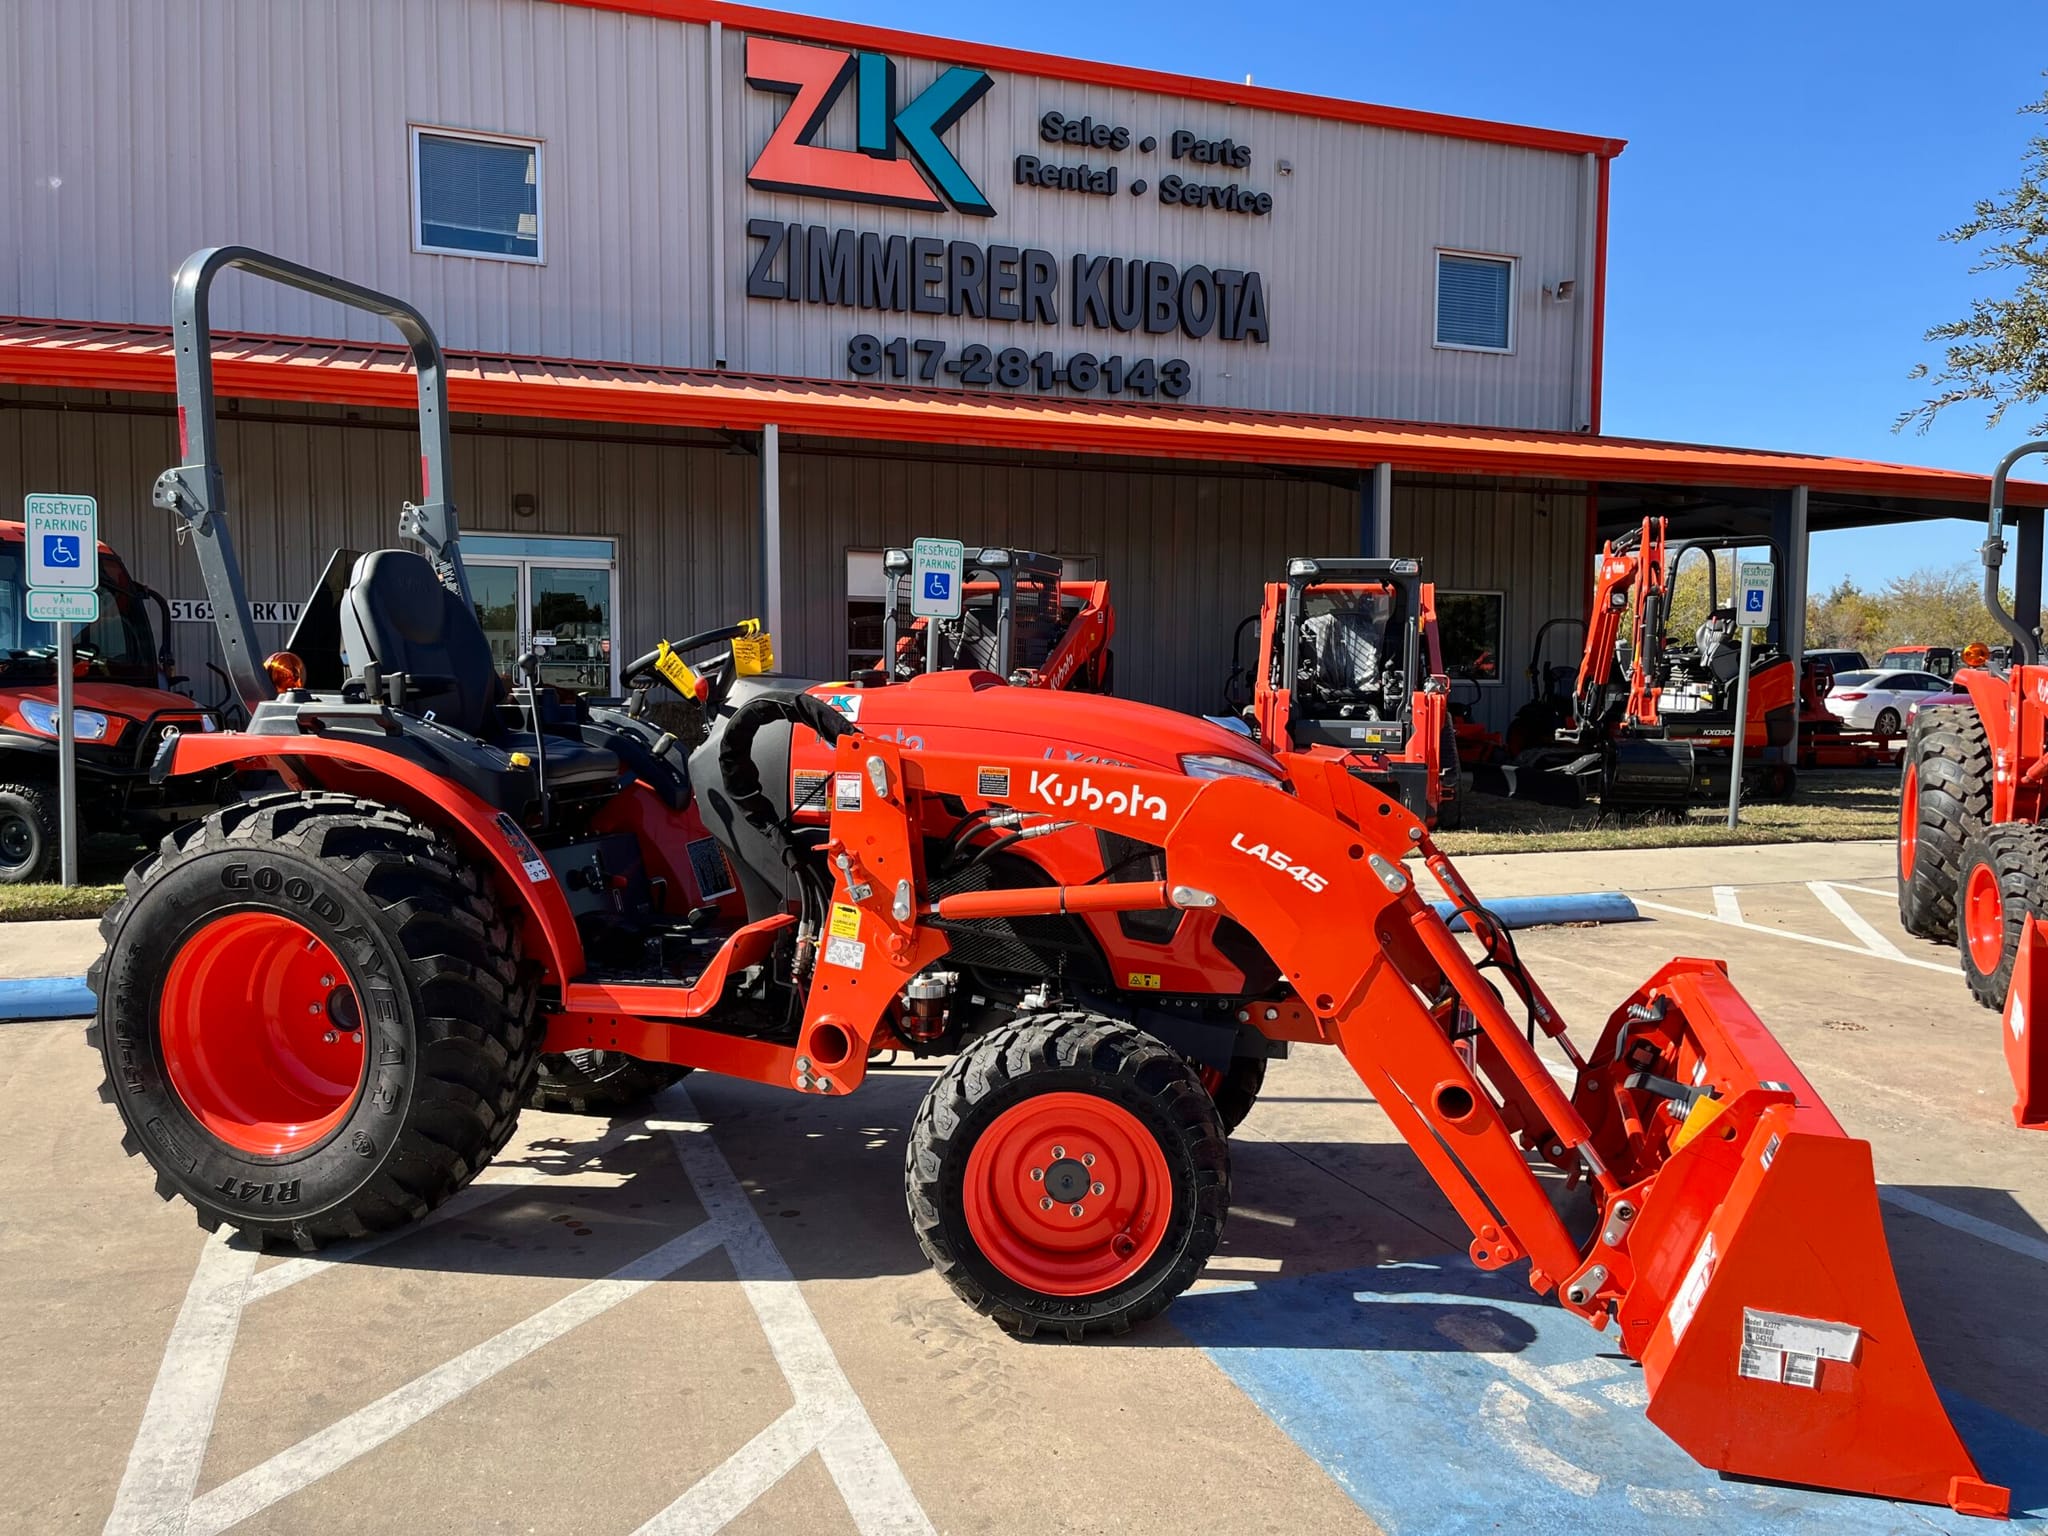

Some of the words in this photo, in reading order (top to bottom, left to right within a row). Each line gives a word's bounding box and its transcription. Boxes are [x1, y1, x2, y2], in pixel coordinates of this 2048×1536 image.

[745, 35, 997, 218] ZK
[1041, 110, 1129, 153] Sales
[1172, 129, 1251, 170] Parts
[1016, 154, 1117, 197] Rental
[1159, 174, 1273, 215] Service
[747, 218, 1058, 325] ZIMMERER
[1072, 253, 1270, 343] KUBOTA
[848, 333, 1191, 398] 817-281-6143
[31, 502, 92, 516] RESERVED
[35, 518, 88, 532] PARKING
[917, 544, 960, 558] RESERVED
[919, 558, 957, 570] PARKING
[1743, 567, 1771, 577] RESERVED
[1743, 578, 1769, 588] PARKING
[32, 606, 93, 616] ACCESSIBLE
[52, 596, 73, 605] VAN
[171, 602, 215, 619] 5165
[1029, 770, 1167, 821] Kubota
[1230, 832, 1329, 893] LA545
[220, 862, 406, 1116] GOODYEAR
[214, 1177, 302, 1206] R14T
